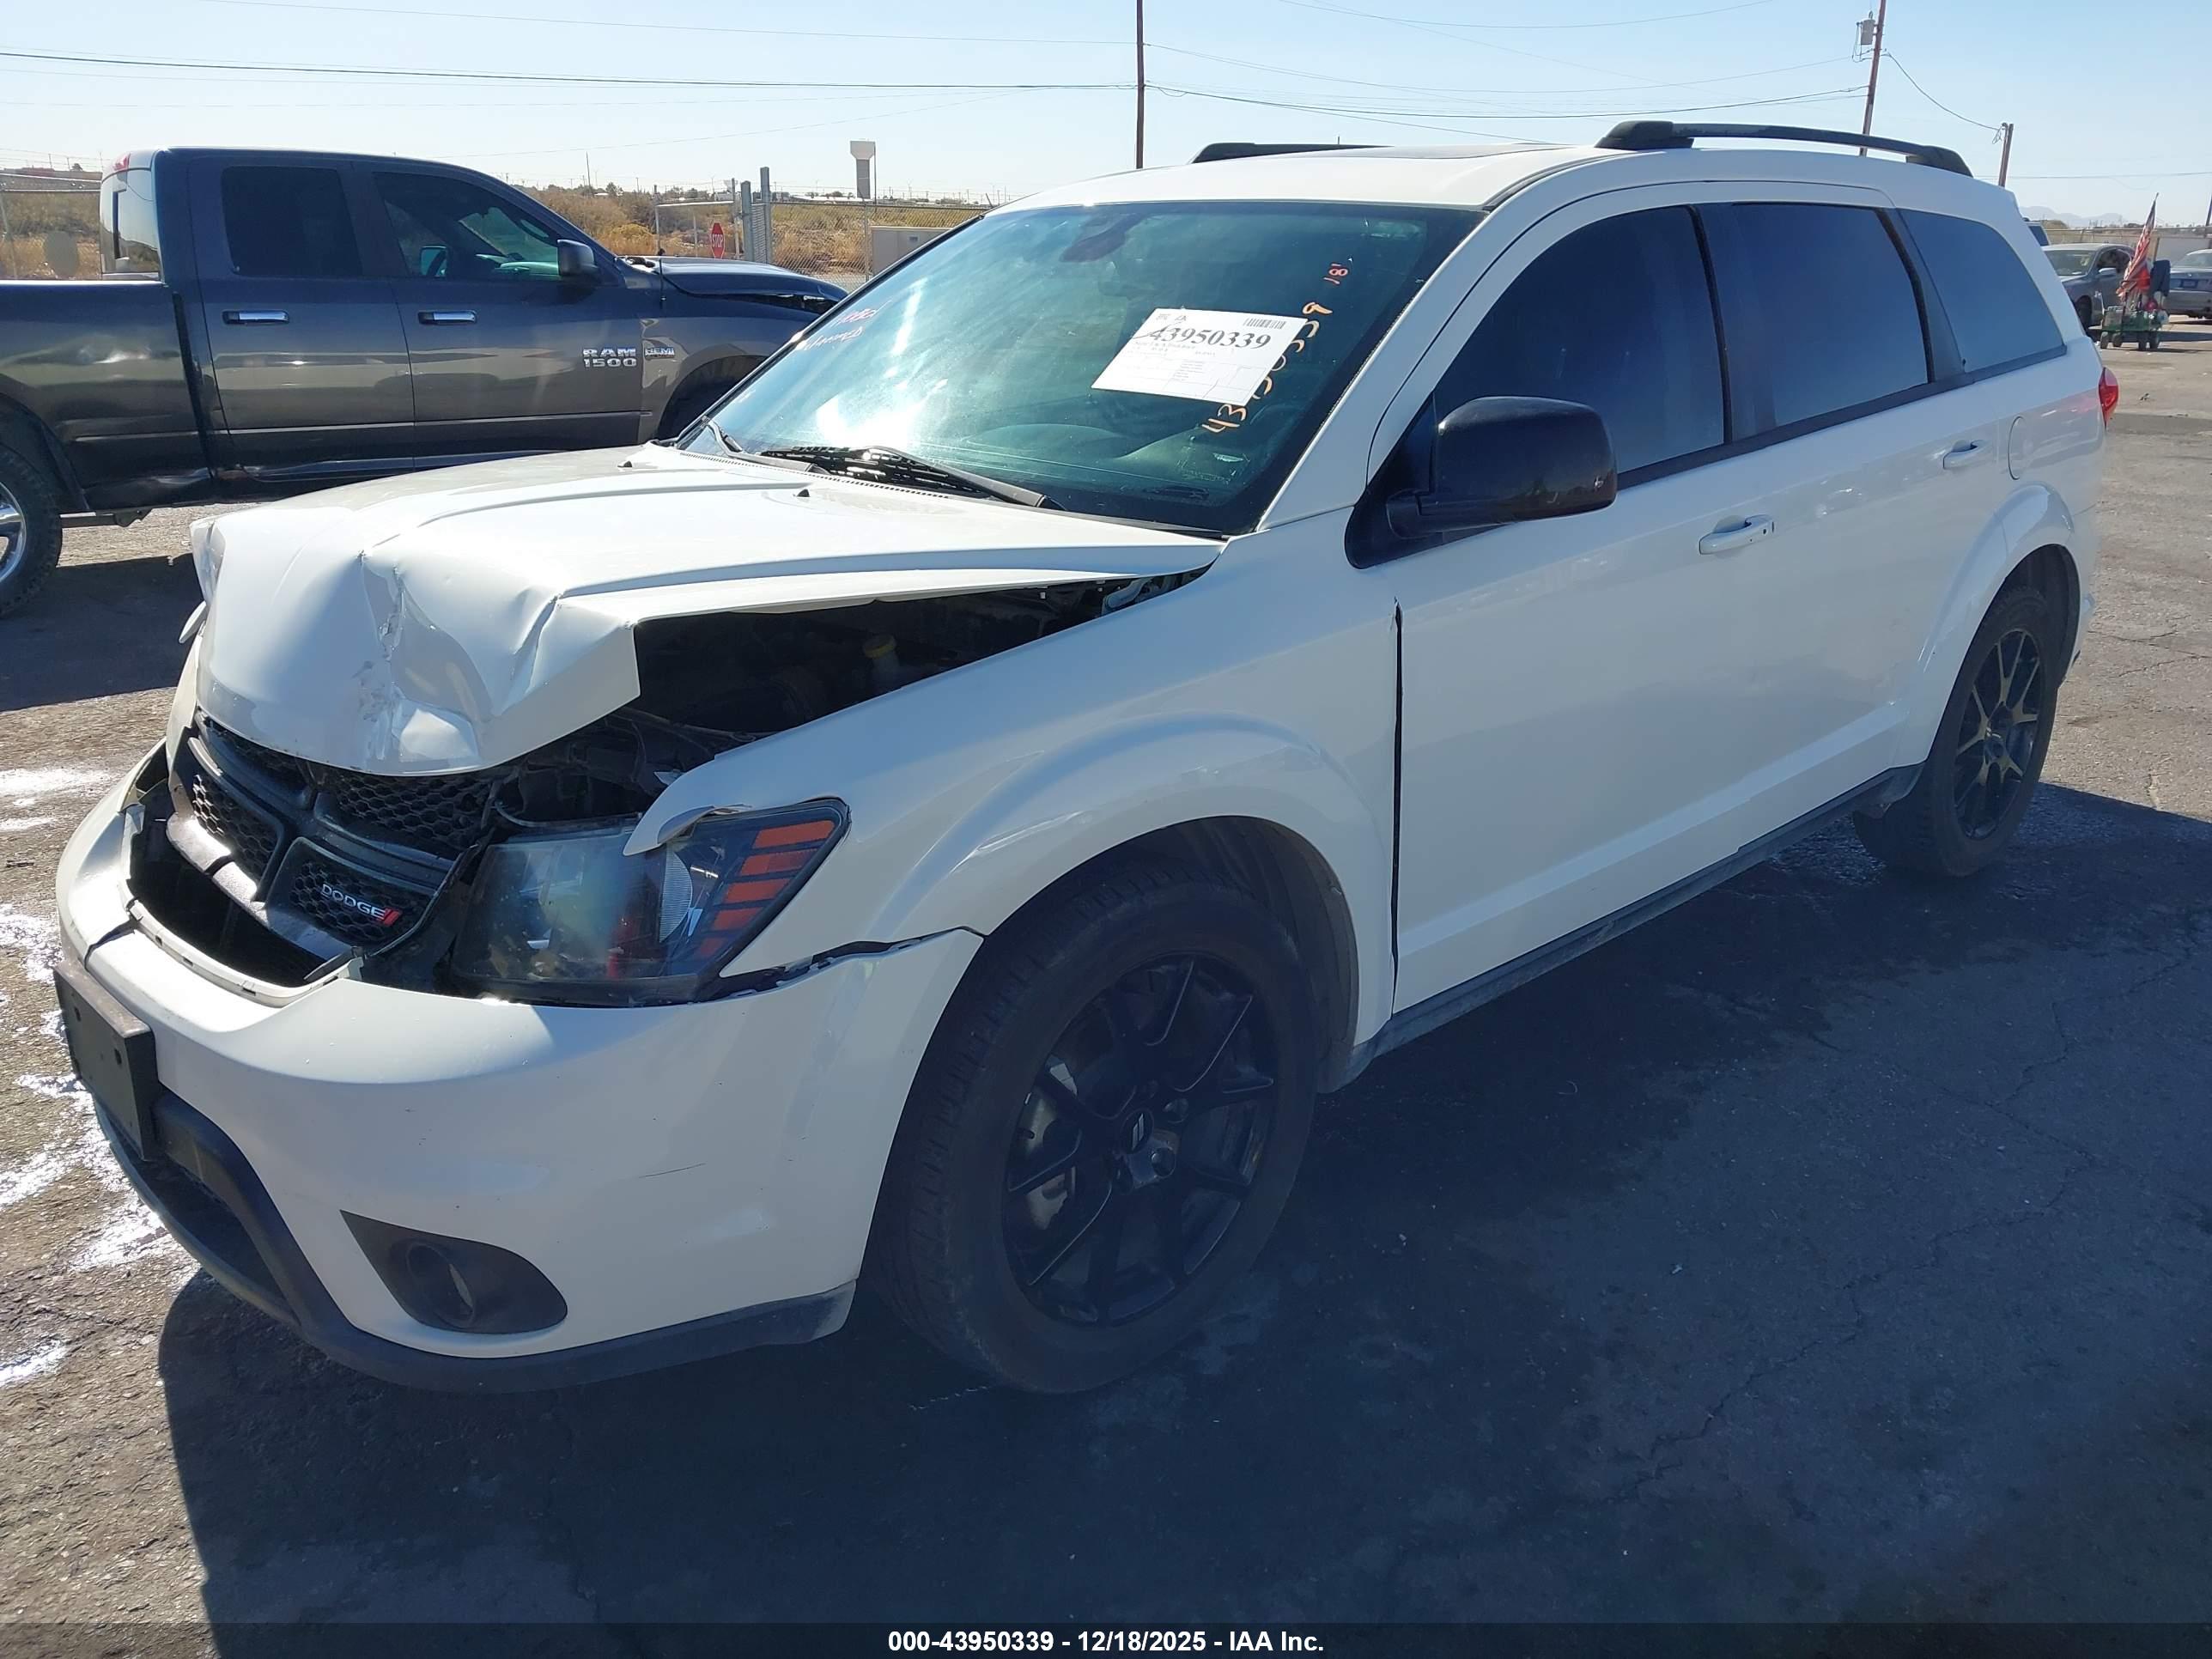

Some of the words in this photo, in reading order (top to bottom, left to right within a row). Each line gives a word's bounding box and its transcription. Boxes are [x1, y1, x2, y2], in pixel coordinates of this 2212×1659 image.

[712, 234, 724, 248] STOP
[1148, 326, 1272, 349] 43950339
[582, 347, 636, 357] RAM
[582, 357, 637, 368] 1500
[320, 883, 386, 921] DODGE
